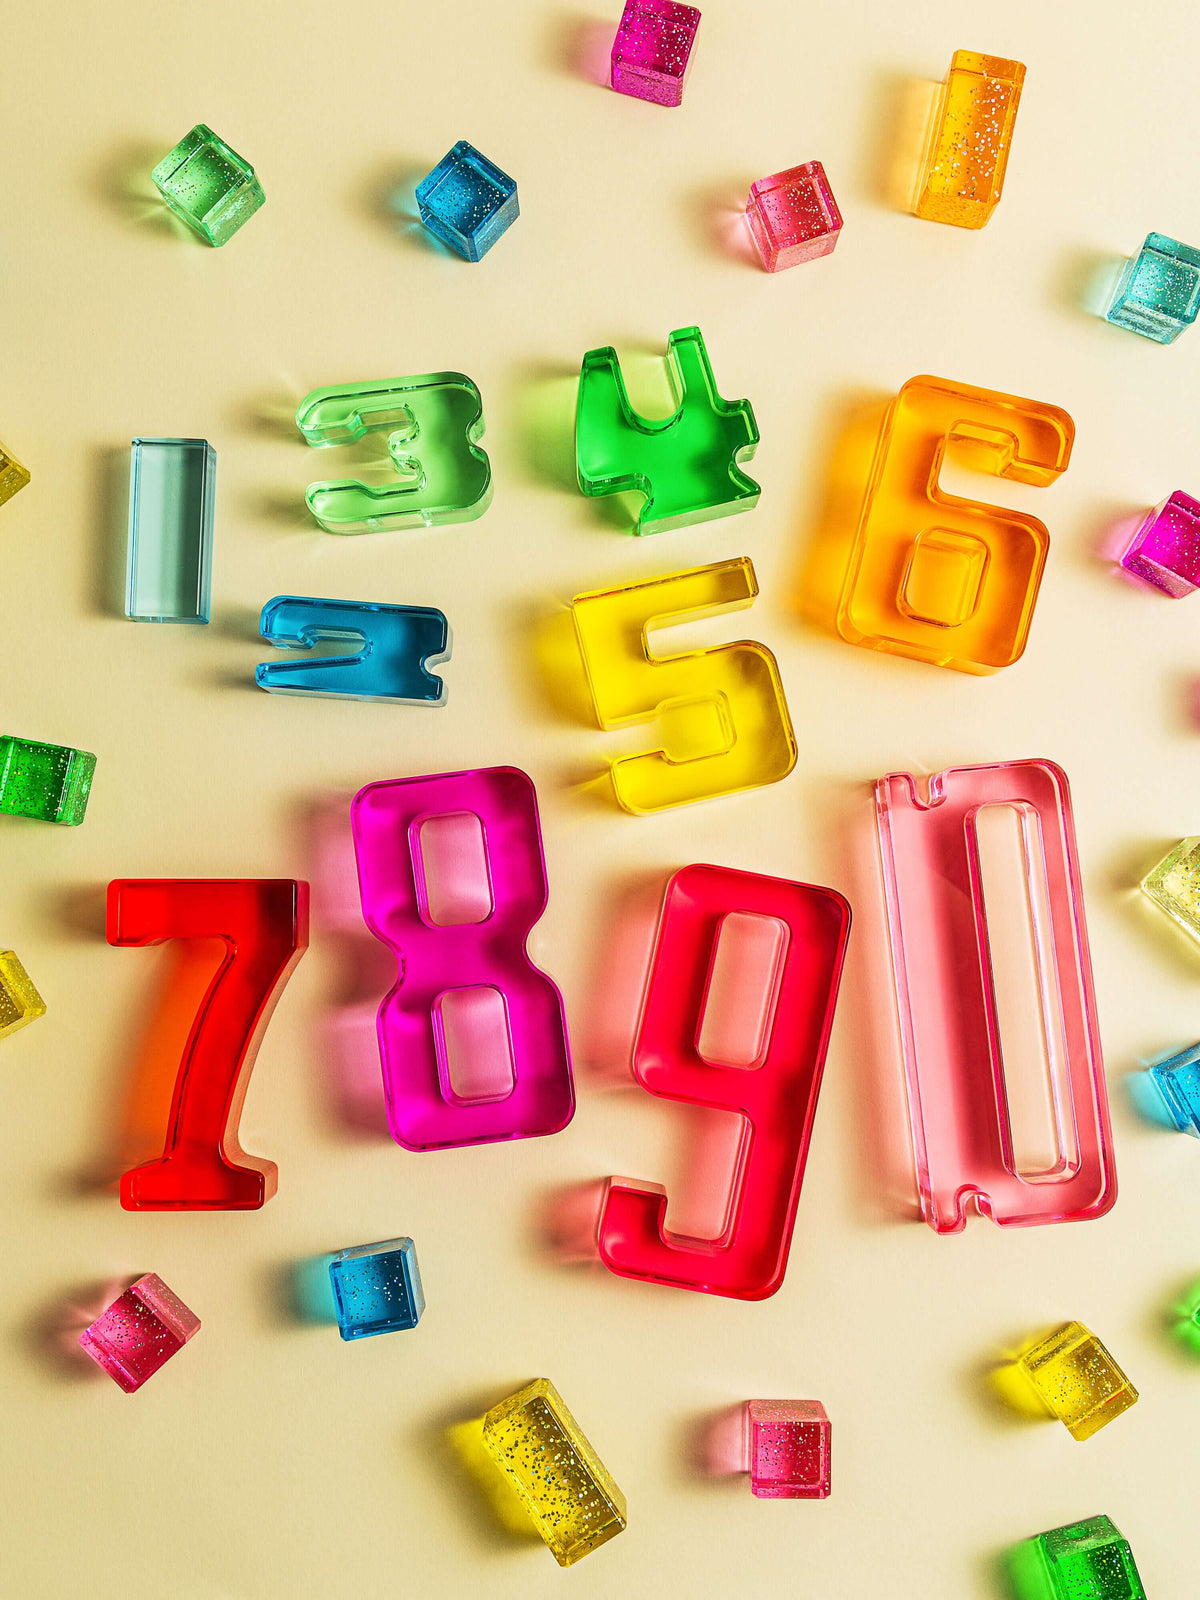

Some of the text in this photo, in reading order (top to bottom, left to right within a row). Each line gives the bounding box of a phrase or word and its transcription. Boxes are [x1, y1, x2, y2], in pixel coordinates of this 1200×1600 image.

[124, 437, 217, 623] 1
[296, 371, 494, 535] 3
[575, 326, 761, 536] 4
[836, 374, 1076, 676] 6
[255, 594, 454, 708] 2
[571, 556, 798, 816] 5
[106, 878, 310, 1212] 7
[351, 765, 576, 1153] 8
[597, 863, 852, 1302] 9
